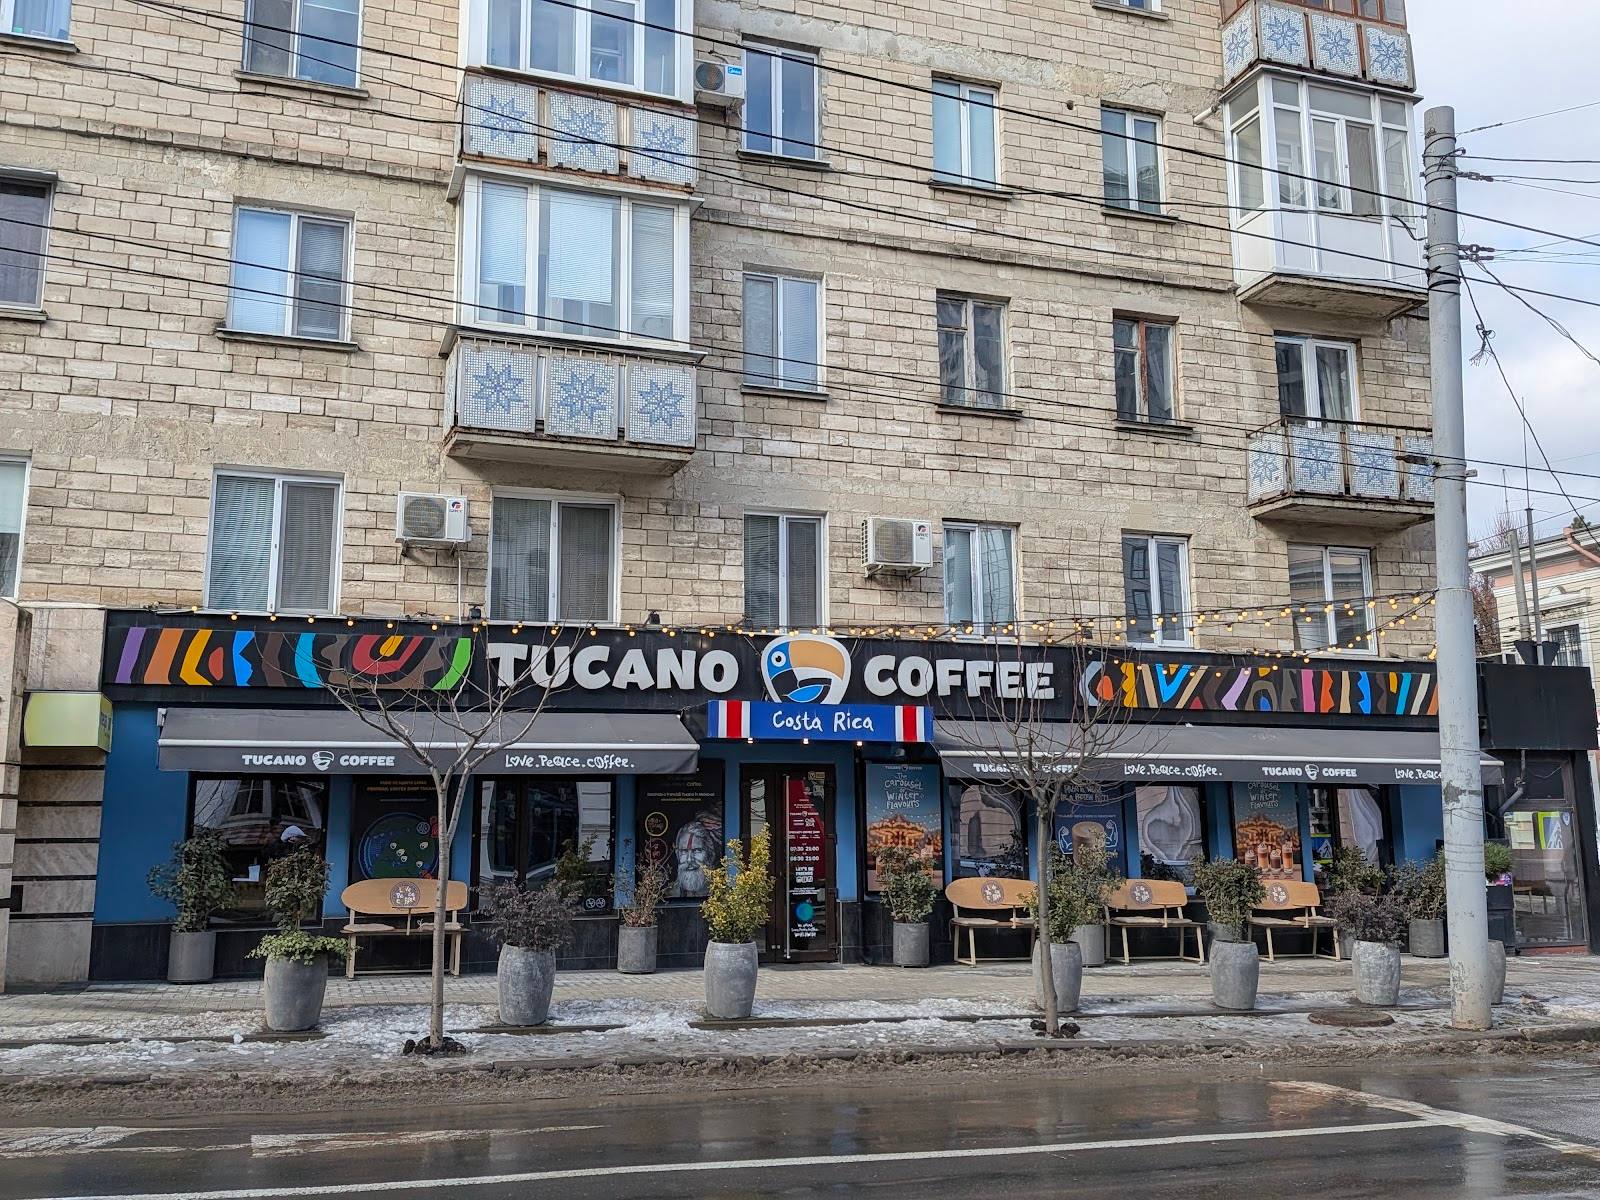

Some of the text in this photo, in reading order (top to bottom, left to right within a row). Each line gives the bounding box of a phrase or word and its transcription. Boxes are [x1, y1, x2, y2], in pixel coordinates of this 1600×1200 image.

[486, 642, 1054, 699] TUCANO COFFEE
[772, 711, 874, 732] Costa Rica
[242, 754, 395, 767] TUCANO COFFEE
[1262, 766, 1357, 777] TUCANO COFFEE
